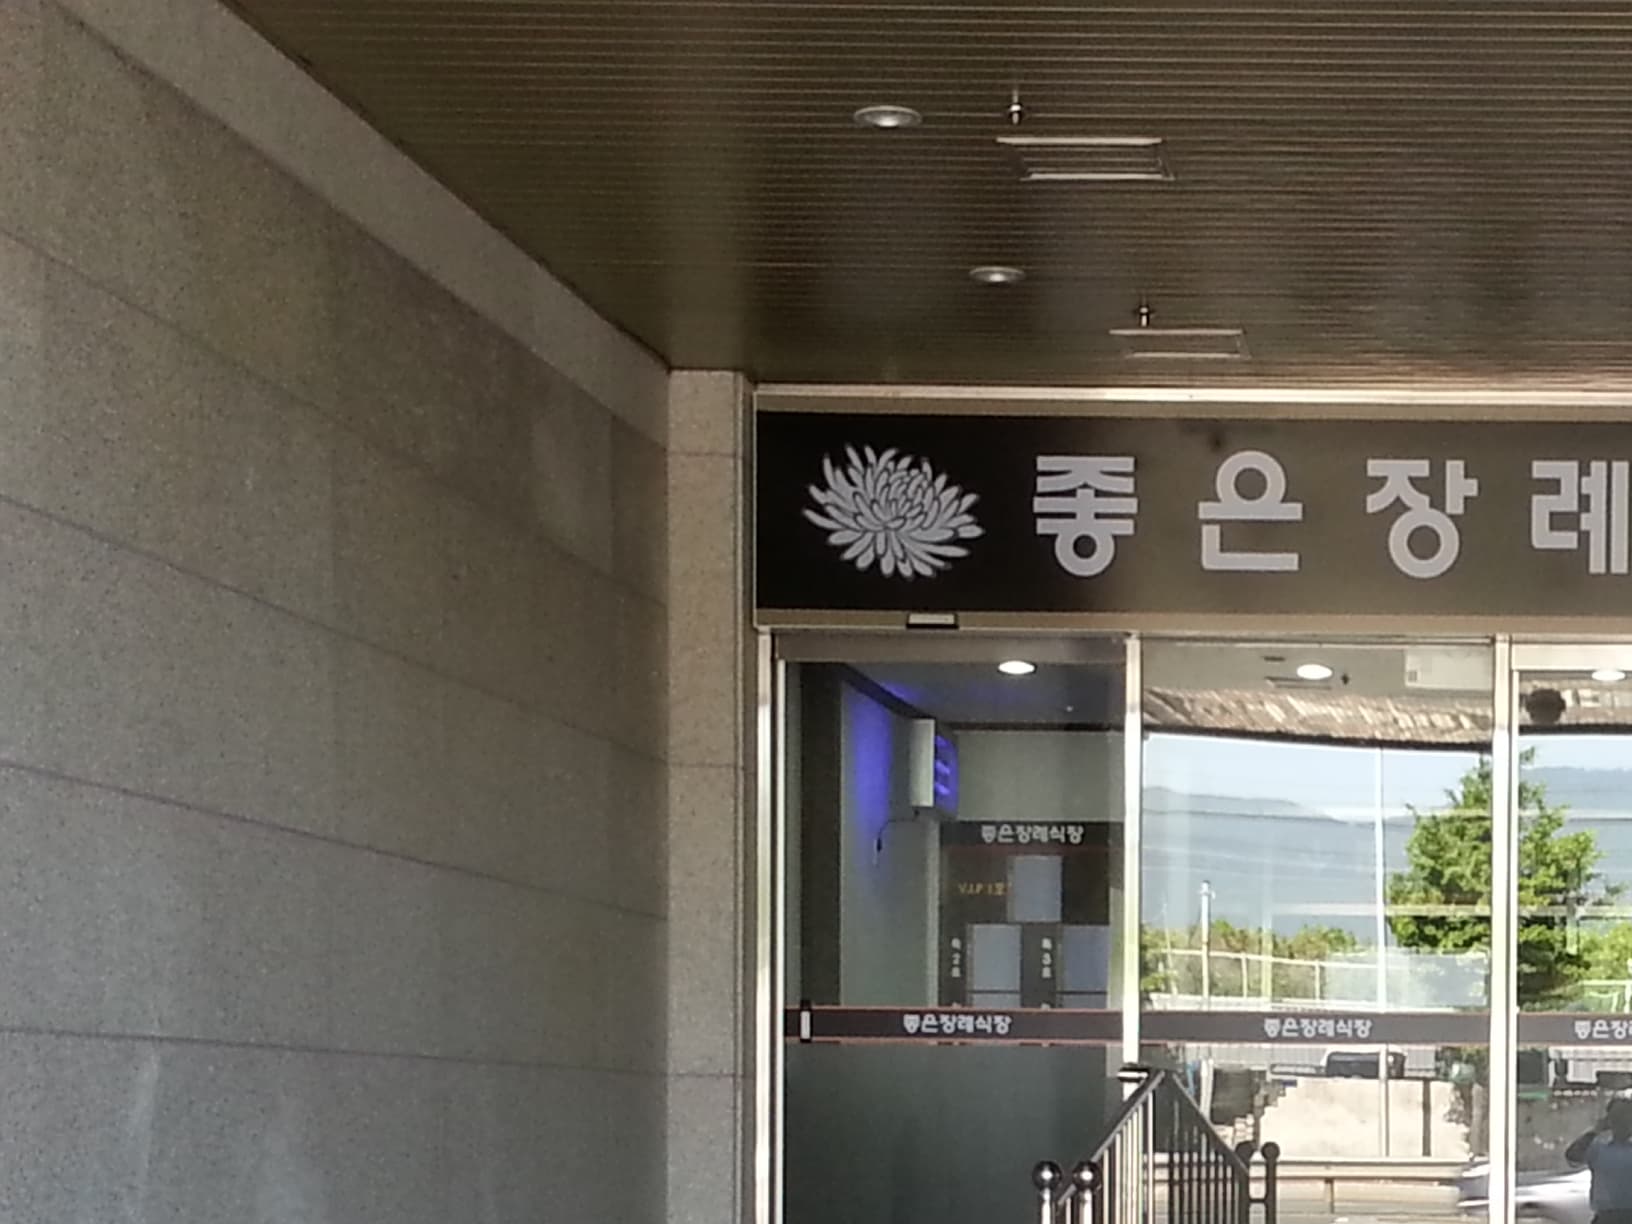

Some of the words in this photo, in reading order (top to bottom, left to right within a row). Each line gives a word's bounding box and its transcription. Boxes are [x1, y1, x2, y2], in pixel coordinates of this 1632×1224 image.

[980, 824, 1085, 844] 좋은장례식장
[903, 1013, 1013, 1035] 좋은장례식장
[1263, 1017, 1373, 1039] 좋은장례식장
